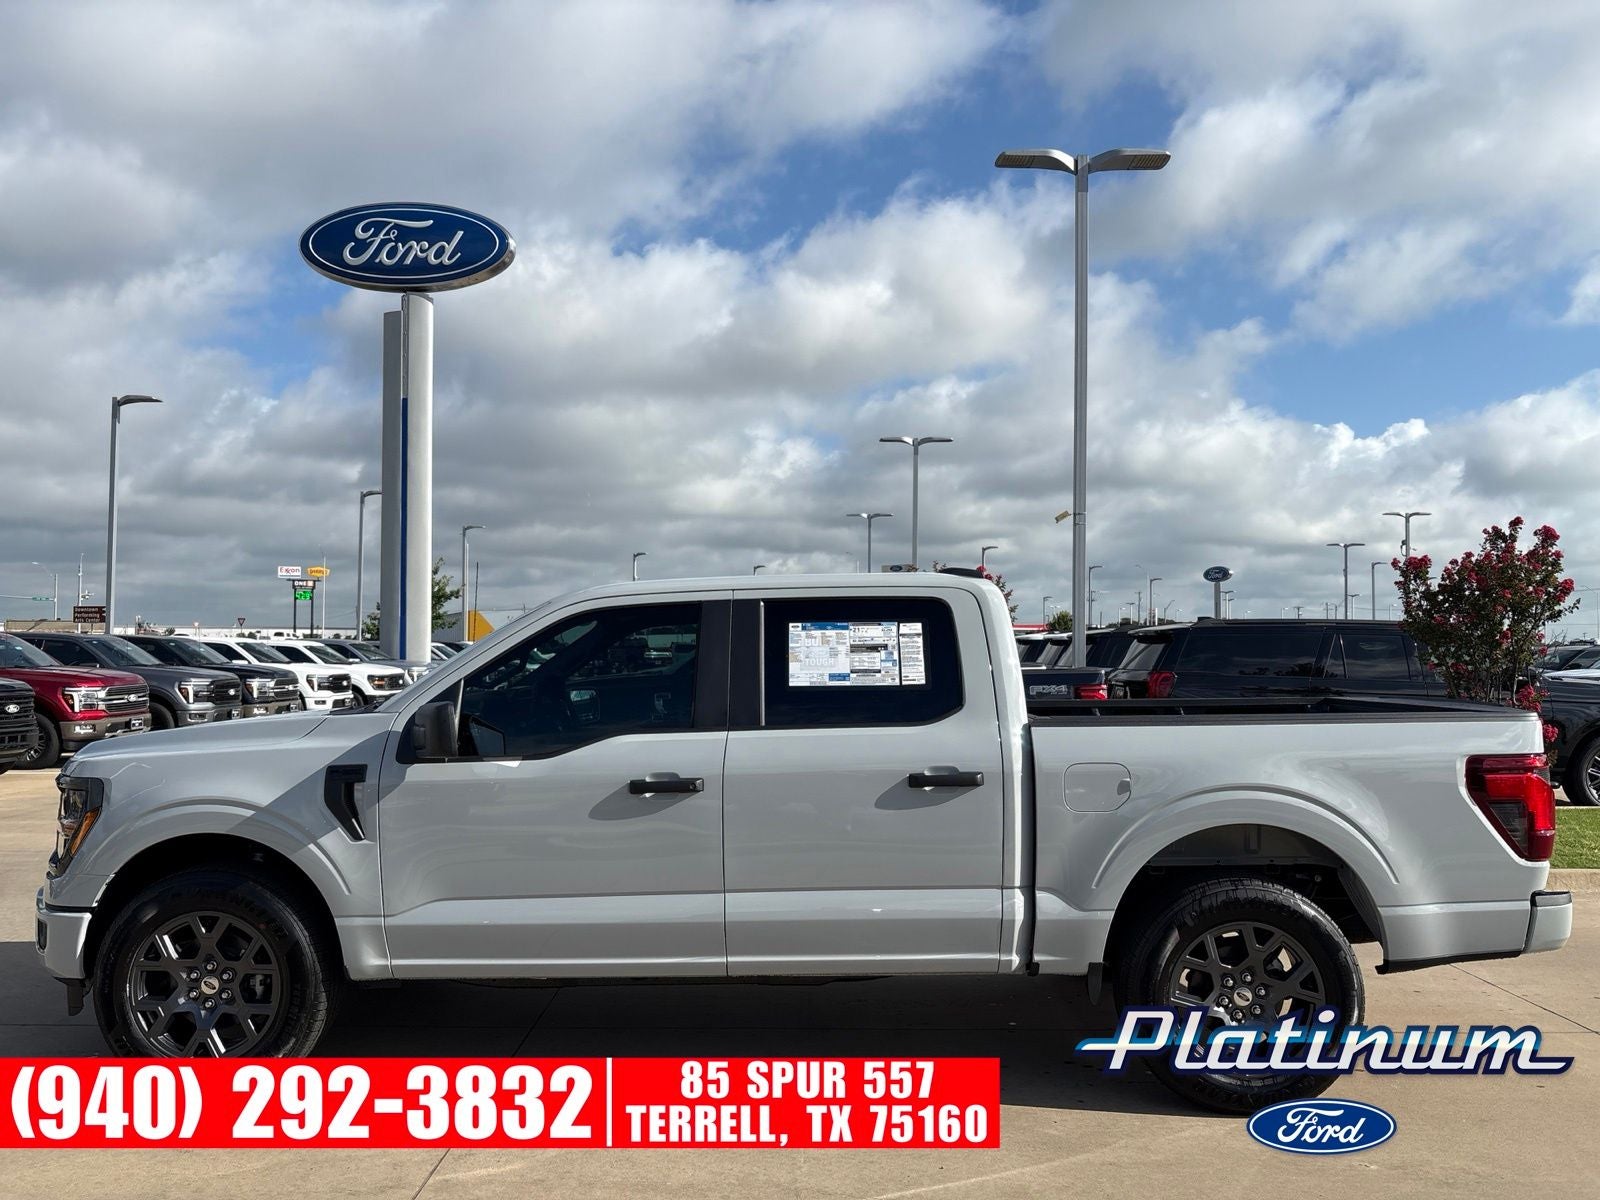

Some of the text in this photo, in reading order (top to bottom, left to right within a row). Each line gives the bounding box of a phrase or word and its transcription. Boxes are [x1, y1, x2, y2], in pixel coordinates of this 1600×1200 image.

[342, 217, 464, 266] Ford
[279, 566, 300, 575] Exxon
[1029, 684, 1068, 695] FX4
